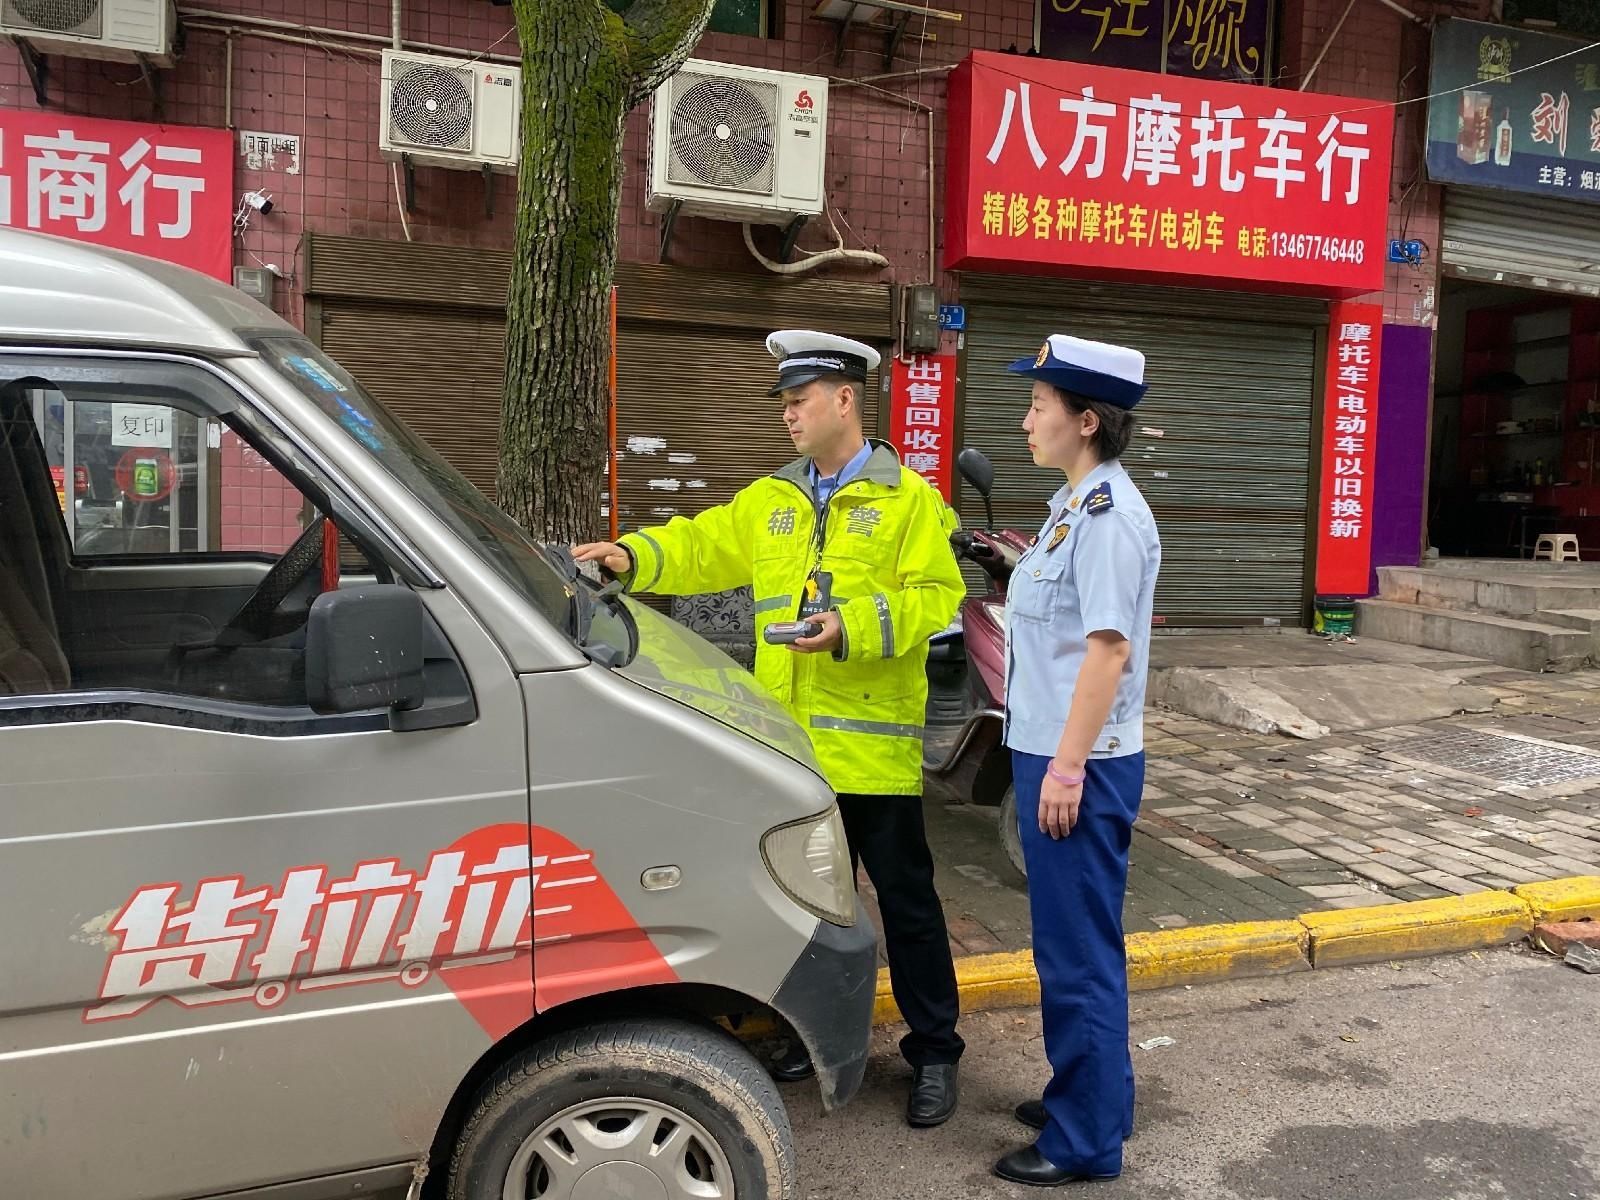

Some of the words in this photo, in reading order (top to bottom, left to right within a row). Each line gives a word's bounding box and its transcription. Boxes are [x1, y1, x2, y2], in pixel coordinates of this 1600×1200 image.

[986, 82, 1370, 205] 八方摩托车行
[982, 190, 1225, 254] 精修各种摩托车/电动车
[120, 416, 165, 438] 复印
[1330, 322, 1372, 539] 摩托车/电动车以旧换新
[83, 843, 597, 1021] 货拉拉
